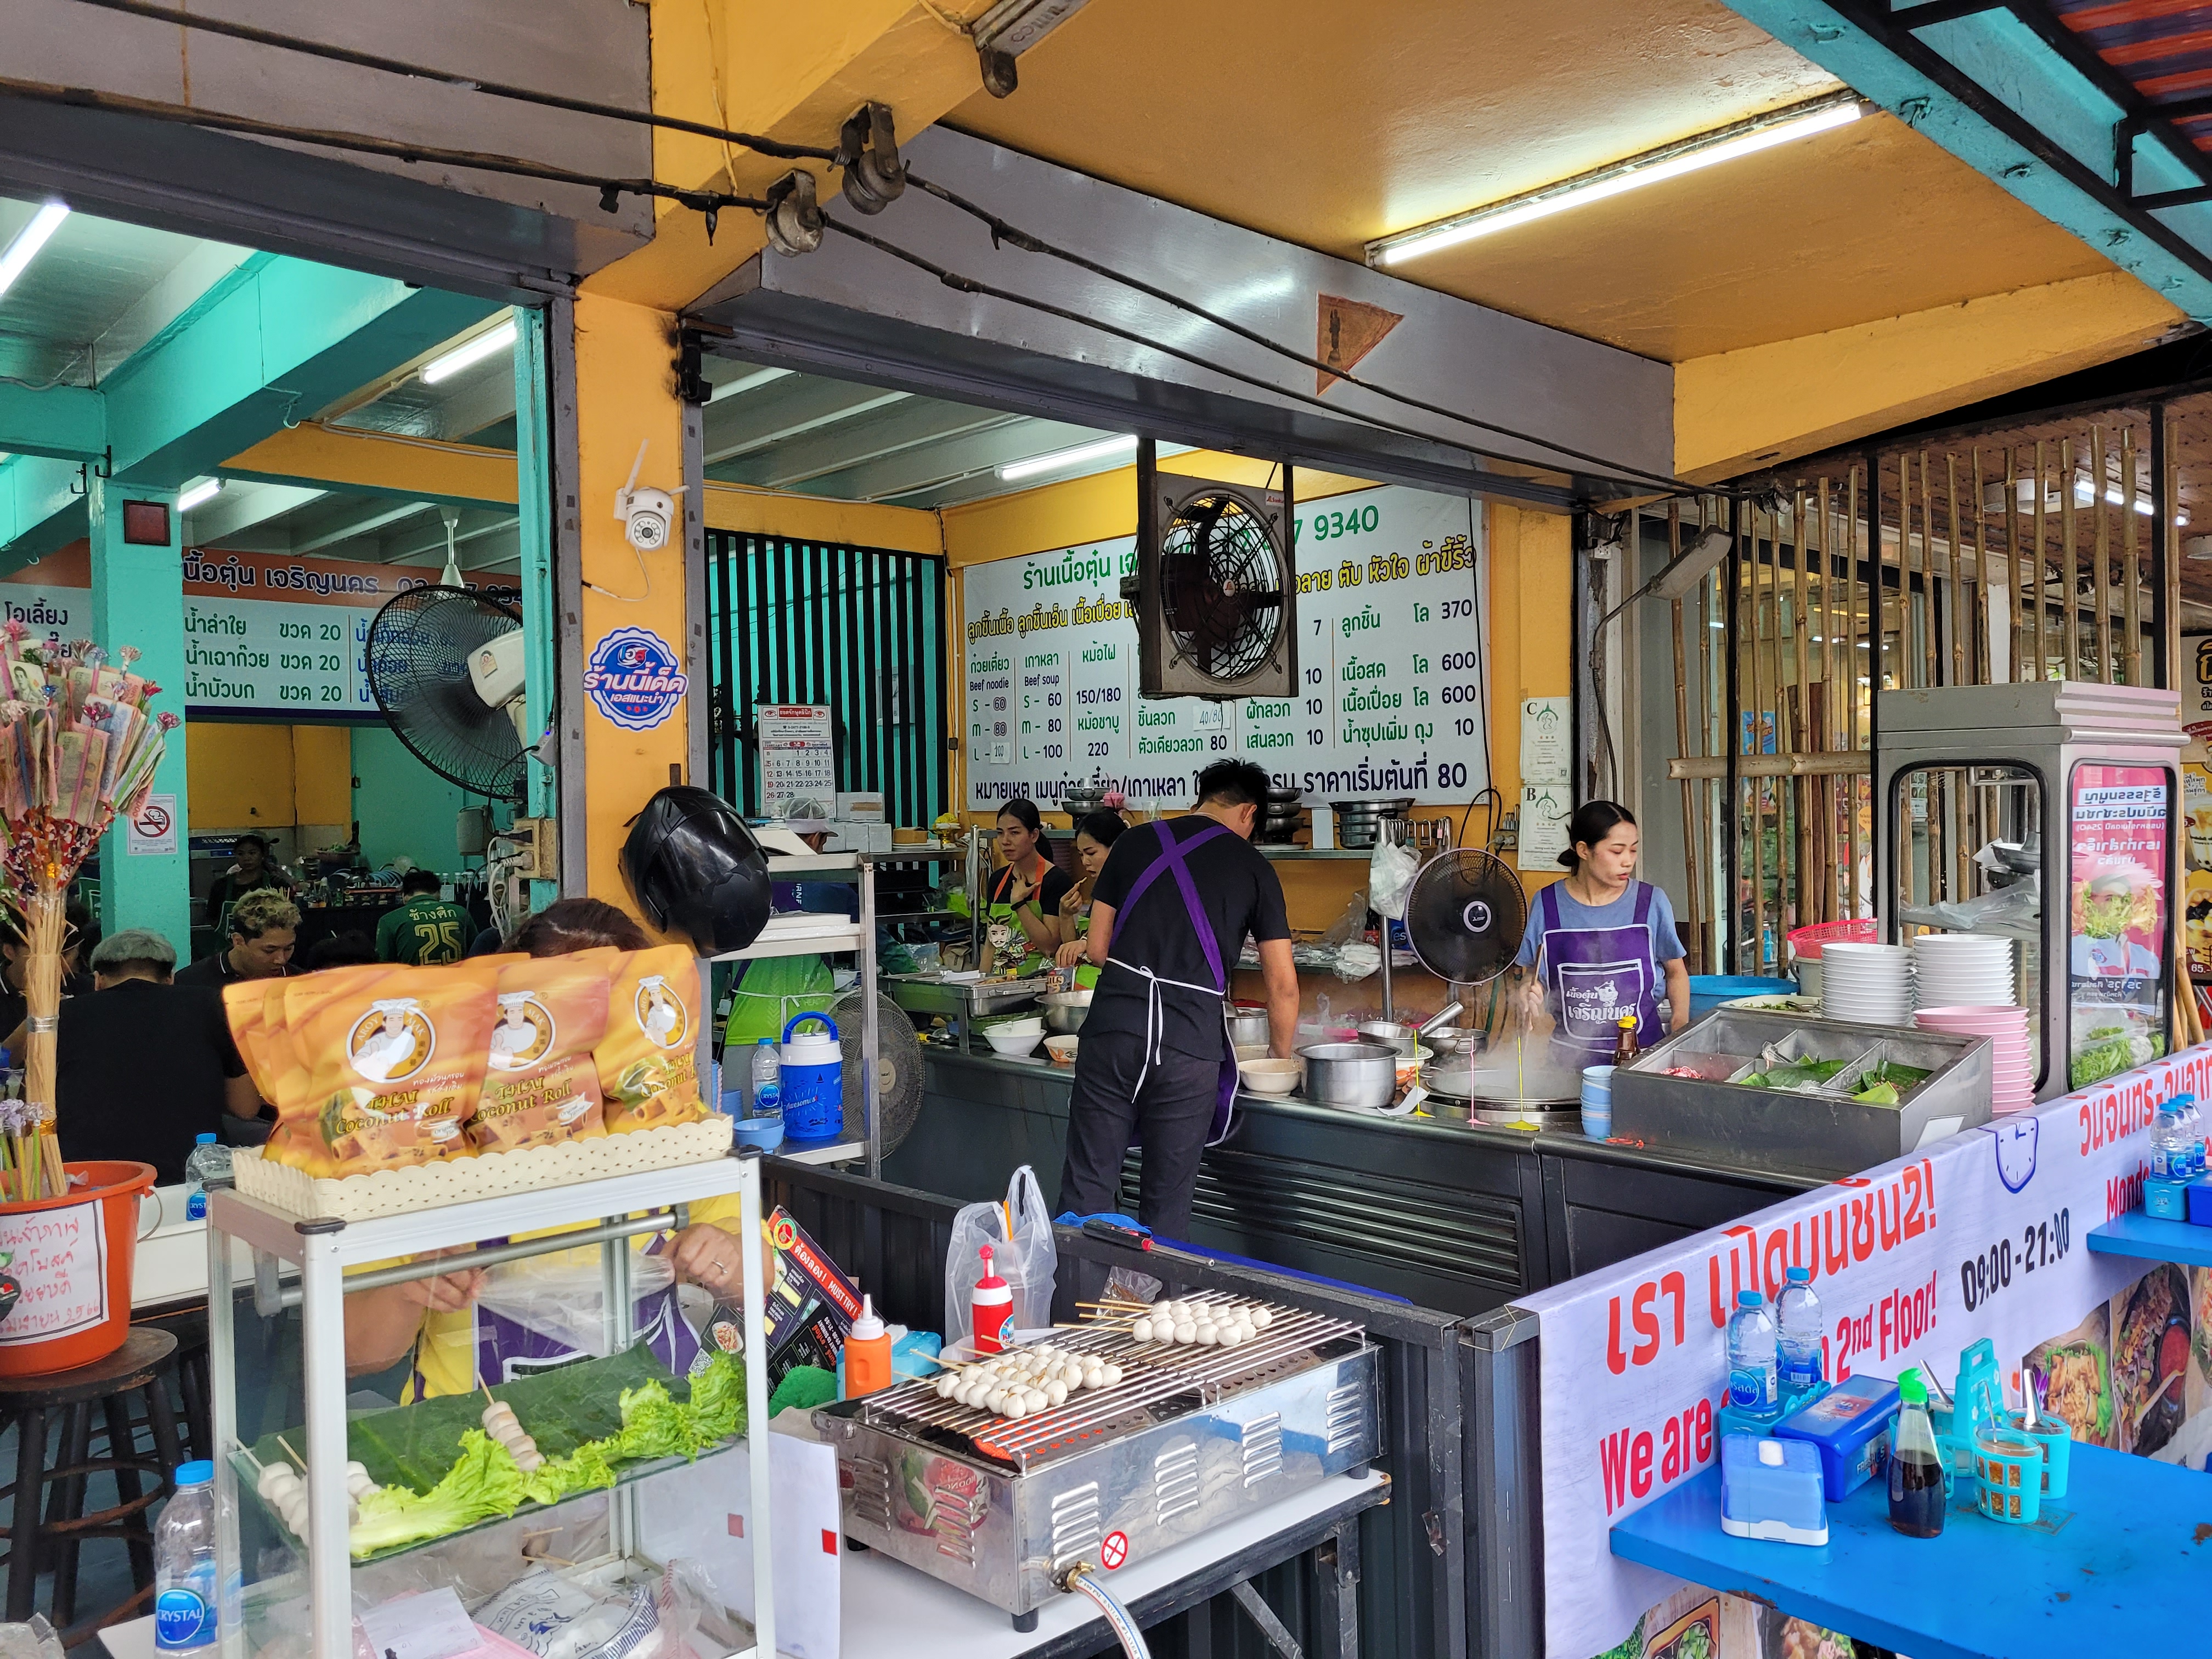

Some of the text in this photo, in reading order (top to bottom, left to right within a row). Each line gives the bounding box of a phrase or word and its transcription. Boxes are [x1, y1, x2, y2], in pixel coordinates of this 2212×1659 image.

[1314, 505, 1379, 541] 9340
[1023, 549, 1111, 590] ร้านเนื้อตุ๋น
[1339, 533, 1477, 586] ตับ หัวใจ ผ้าขี้ริ้ว
[266, 565, 379, 596] เจริญนคร
[967, 607, 1015, 645] ลูกชิ้นเนื้อ
[1017, 602, 1068, 639] ลูกชิ้นเอ็น
[1071, 593, 1122, 626] เนื้อเปื่อย
[1313, 619, 1322, 636] 7
[1341, 599, 1473, 639] ลูกชิ้น โล 370
[279, 622, 312, 641] ขวด
[320, 624, 342, 642] 20
[280, 652, 312, 671] ขวด
[319, 653, 341, 672] 20
[970, 651, 1009, 674] ก๋วยเตี๋ยว
[1025, 652, 1059, 669] เกาเหลา
[1082, 641, 1116, 663] หม้อไฟ
[1306, 668, 1323, 685] 10
[1342, 651, 1476, 682] เนื้อสด โล 600
[185, 671, 256, 700] น้ำบัวบก
[279, 682, 312, 702] ขวด
[320, 684, 342, 703] 20
[584, 662, 686, 693] ร้านนี้เด็ด
[969, 680, 985, 692] Beef
[1024, 674, 1059, 689] Beef soup
[610, 692, 664, 704] เอสแนะนำ
[972, 696, 1007, 713] S 60
[1024, 693, 1062, 710] S 60
[1076, 687, 1122, 705] 150/180
[1306, 698, 1323, 715] 10
[1342, 684, 1477, 713] เนื้อเปื่อย โล 600
[1138, 706, 1223, 727] ชิ้นลวก 40/80
[1526, 702, 1538, 715] C
[994, 721, 1007, 737] 80
[1047, 718, 1062, 733] 80
[1077, 712, 1120, 735] หม้อชาบู
[1342, 714, 1475, 748] น้ำซุปเพิ่ม ถุง 10
[1138, 735, 1227, 755] ตัวเดียวลวก 80
[1246, 724, 1324, 749] เส้นลวก 10
[994, 745, 1005, 758] 100
[1043, 744, 1063, 759] 100
[1087, 741, 1109, 757] 220
[1304, 752, 1427, 794] ราคาเริ่มต้นที่
[1437, 763, 1467, 788] 80
[975, 777, 1030, 800] หมายเหต
[1526, 787, 1536, 801] B
[414, 922, 462, 966] 25
[663, 992, 678, 1007] MAK
[527, 1008, 545, 1026] MAK
[357, 1016, 426, 1041] AROY MAK
[663, 1052, 691, 1075] THAI
[494, 1076, 545, 1100] THAI
[540, 1078, 572, 1104] Roll
[364, 1090, 419, 1110] THAI
[335, 1097, 454, 1135] Coconut Roll
[1961, 1256, 2012, 1312] 09:00
[2025, 1207, 2070, 1275] 21:00
[794, 1242, 827, 1282] ต้องลอง!
[827, 1280, 846, 1302] MUST
[843, 1295, 858, 1316] TRY!
[817, 1319, 829, 1339] SUNDAY
[1605, 1272, 1686, 1376] เรา
[829, 1341, 838, 1356] NDAY
[1599, 1423, 1652, 1518] We
[1662, 1398, 1712, 1483] are
[1837, 1297, 1874, 1377] 2nd
[1878, 1269, 1938, 1362] Floor!
[157, 1609, 203, 1622] CRYSTAL
